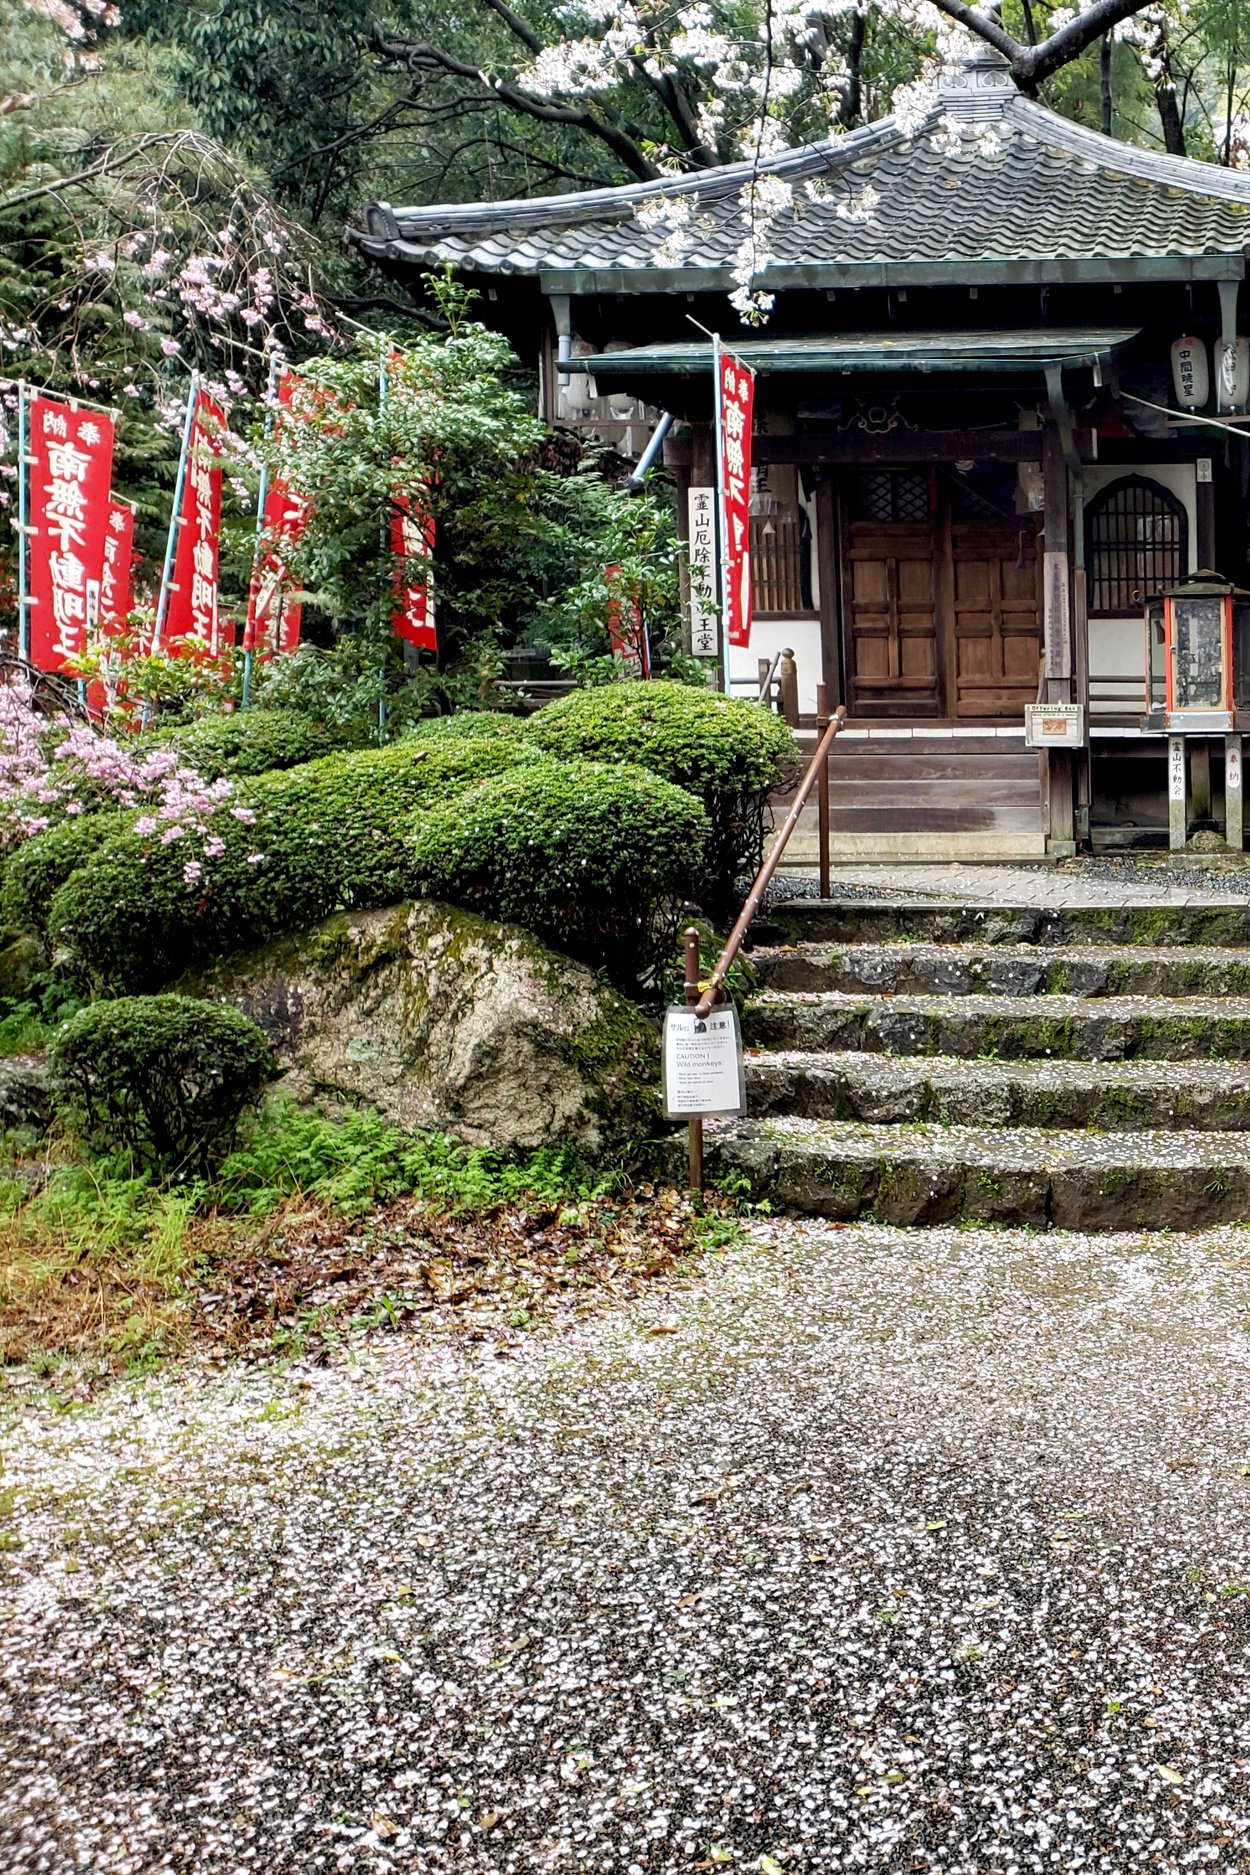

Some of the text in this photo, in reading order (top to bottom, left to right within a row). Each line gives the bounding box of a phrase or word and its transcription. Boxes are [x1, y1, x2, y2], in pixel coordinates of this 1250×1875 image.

[693, 493, 714, 652] 霊山厄除不動王堂
